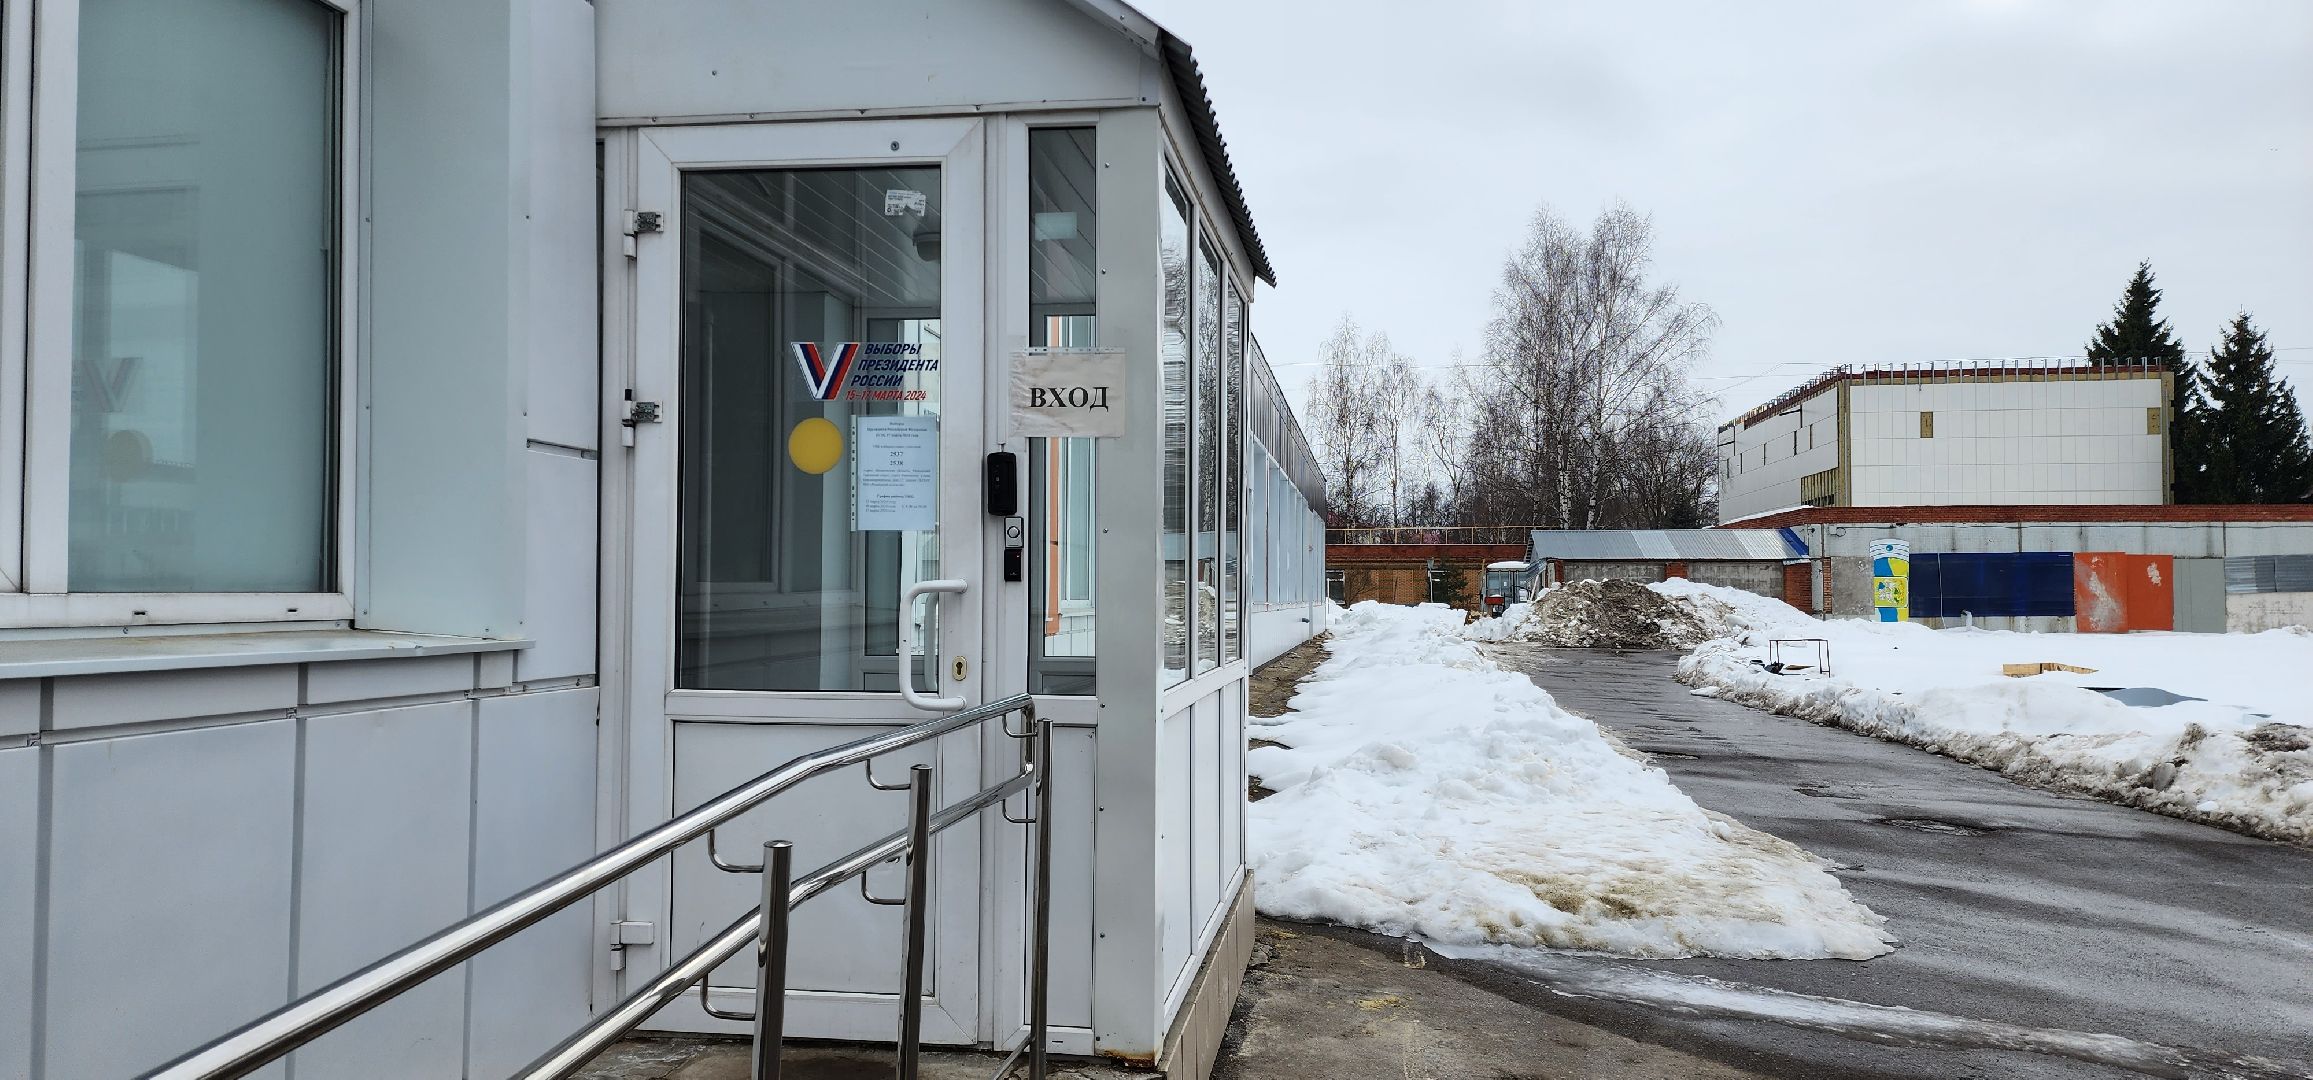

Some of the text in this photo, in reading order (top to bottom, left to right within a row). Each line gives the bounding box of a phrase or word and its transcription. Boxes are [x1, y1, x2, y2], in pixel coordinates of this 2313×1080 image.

[864, 343, 922, 355] ВЫБОРЫ
[858, 359, 939, 372] ПРЕЗИДЕНТА
[851, 375, 904, 387] РОССИИ
[872, 390, 903, 401] МАРТА
[904, 390, 927, 401] 2024
[1029, 386, 1109, 413] ВХОД
